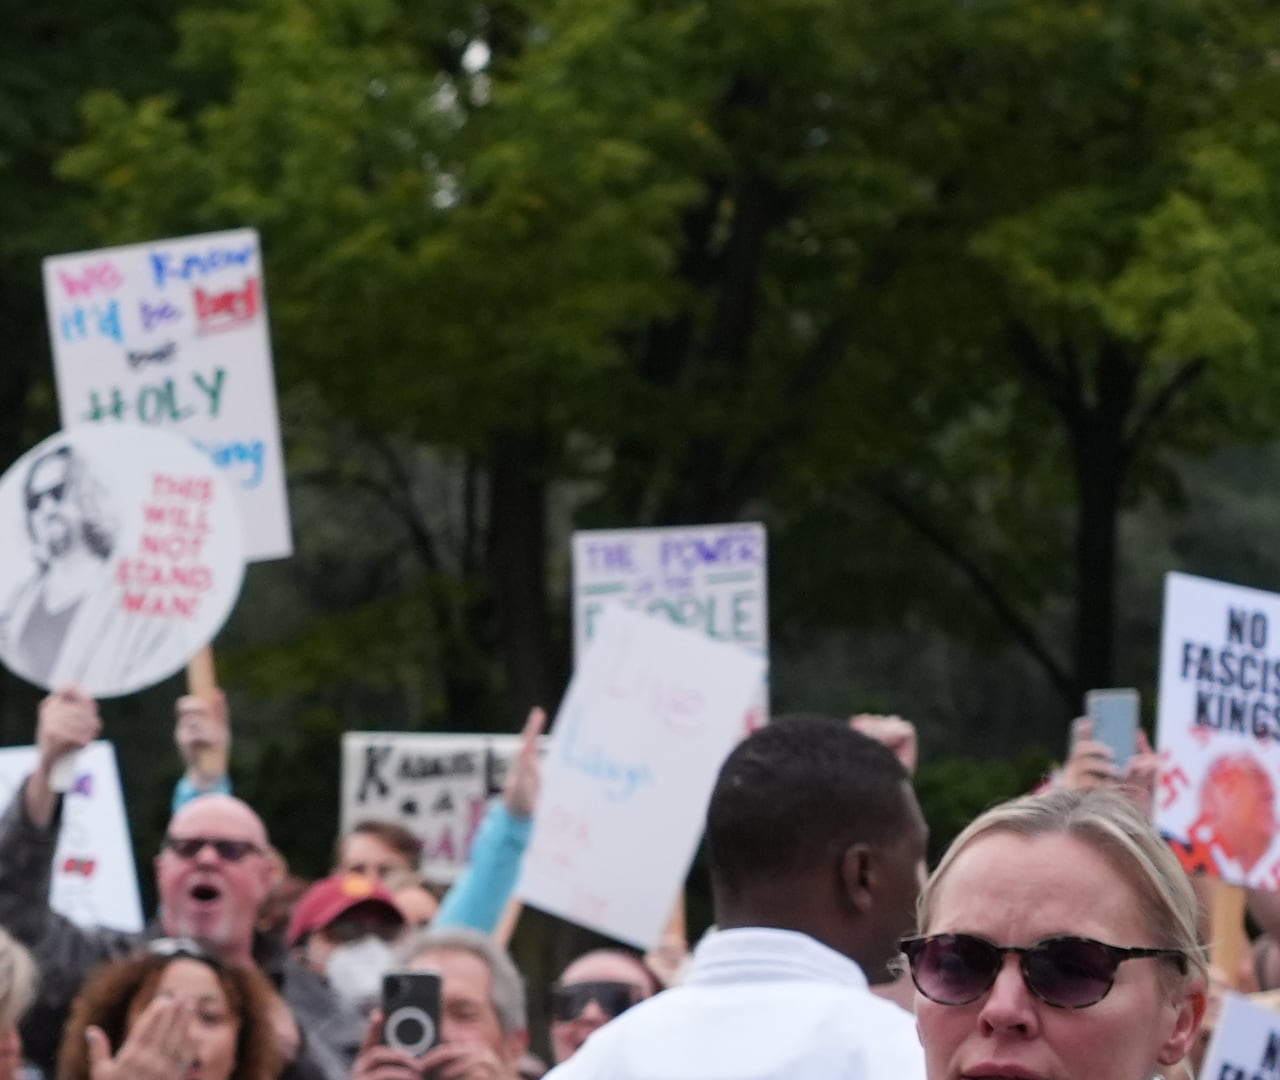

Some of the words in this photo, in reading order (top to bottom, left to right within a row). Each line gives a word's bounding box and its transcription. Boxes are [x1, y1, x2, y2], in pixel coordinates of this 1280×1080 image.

[83, 367, 227, 425] HOLY
[151, 474, 215, 503] THIS
[144, 506, 213, 534] WILL
[141, 536, 204, 559] NOT
[659, 532, 762, 576] POWER
[116, 560, 214, 590] STAND
[1226, 605, 1268, 650] NO
